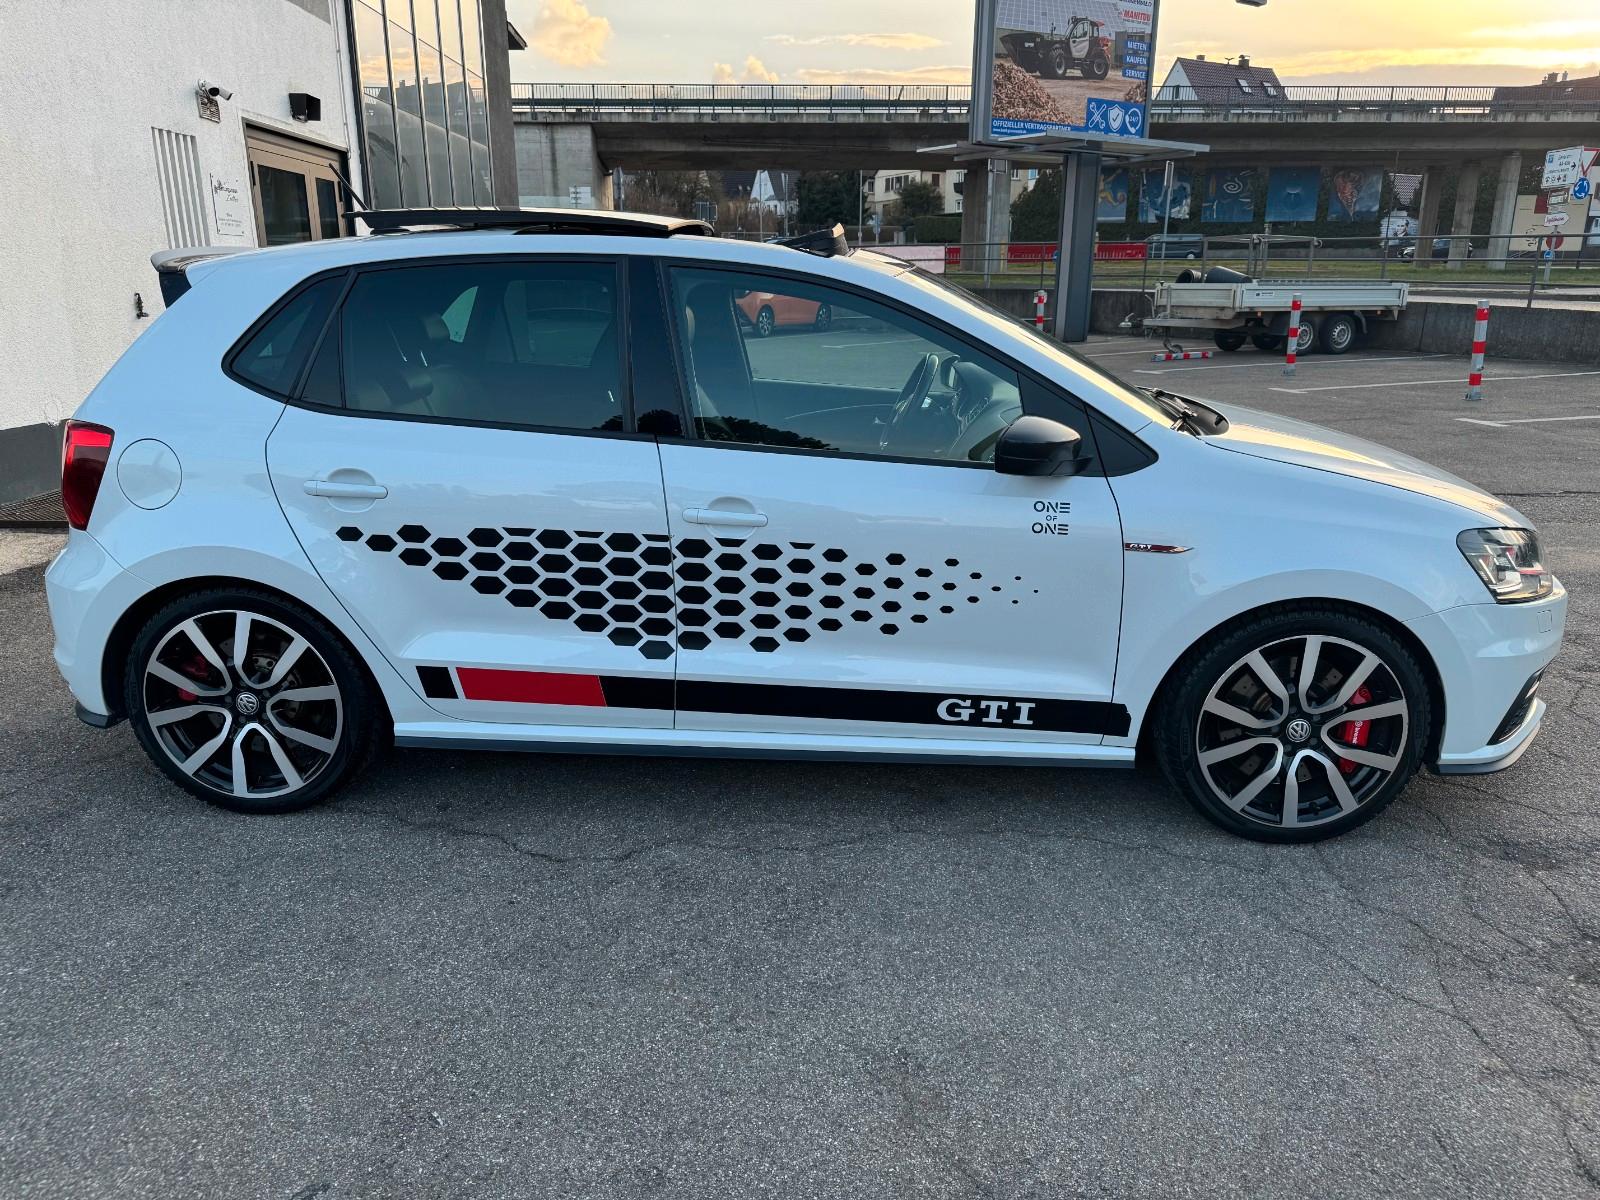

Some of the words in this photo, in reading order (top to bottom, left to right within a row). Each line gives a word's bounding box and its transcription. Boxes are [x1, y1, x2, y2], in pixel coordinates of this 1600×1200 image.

[1122, 9, 1151, 22] MANITOU
[1127, 41, 1147, 51] MIETEN
[1126, 55, 1147, 65] KAUFEN
[1125, 69, 1146, 79] SERVICE
[992, 119, 1024, 129] OFFIZIELLER
[1033, 500, 1071, 513] ONE
[1045, 514, 1058, 522] OF
[1031, 522, 1069, 536] ONE
[936, 698, 1036, 725] GTI
